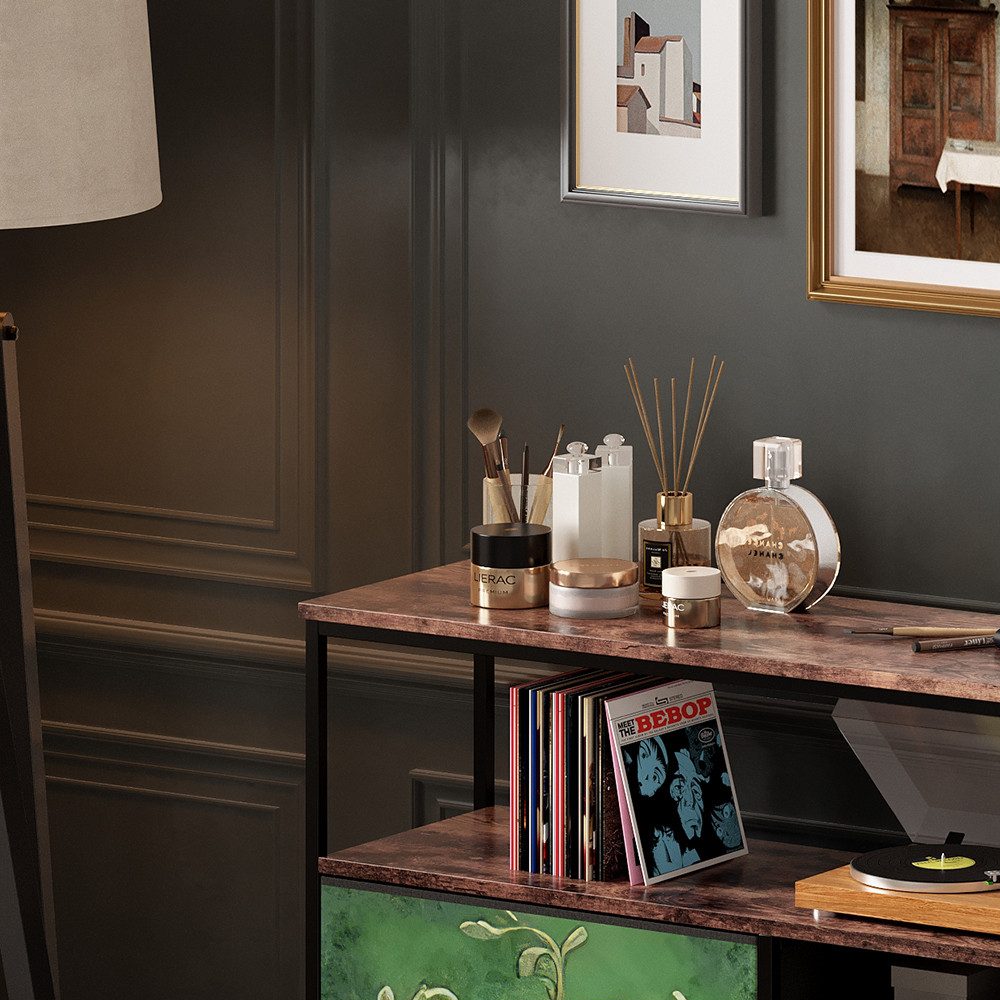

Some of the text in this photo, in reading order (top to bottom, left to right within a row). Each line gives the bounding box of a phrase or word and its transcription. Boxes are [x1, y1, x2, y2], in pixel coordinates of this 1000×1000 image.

[473, 573, 516, 586] LIERAC
[635, 697, 712, 734] BEBOP
[617, 718, 635, 730] MEET
[619, 726, 636, 738] THE
